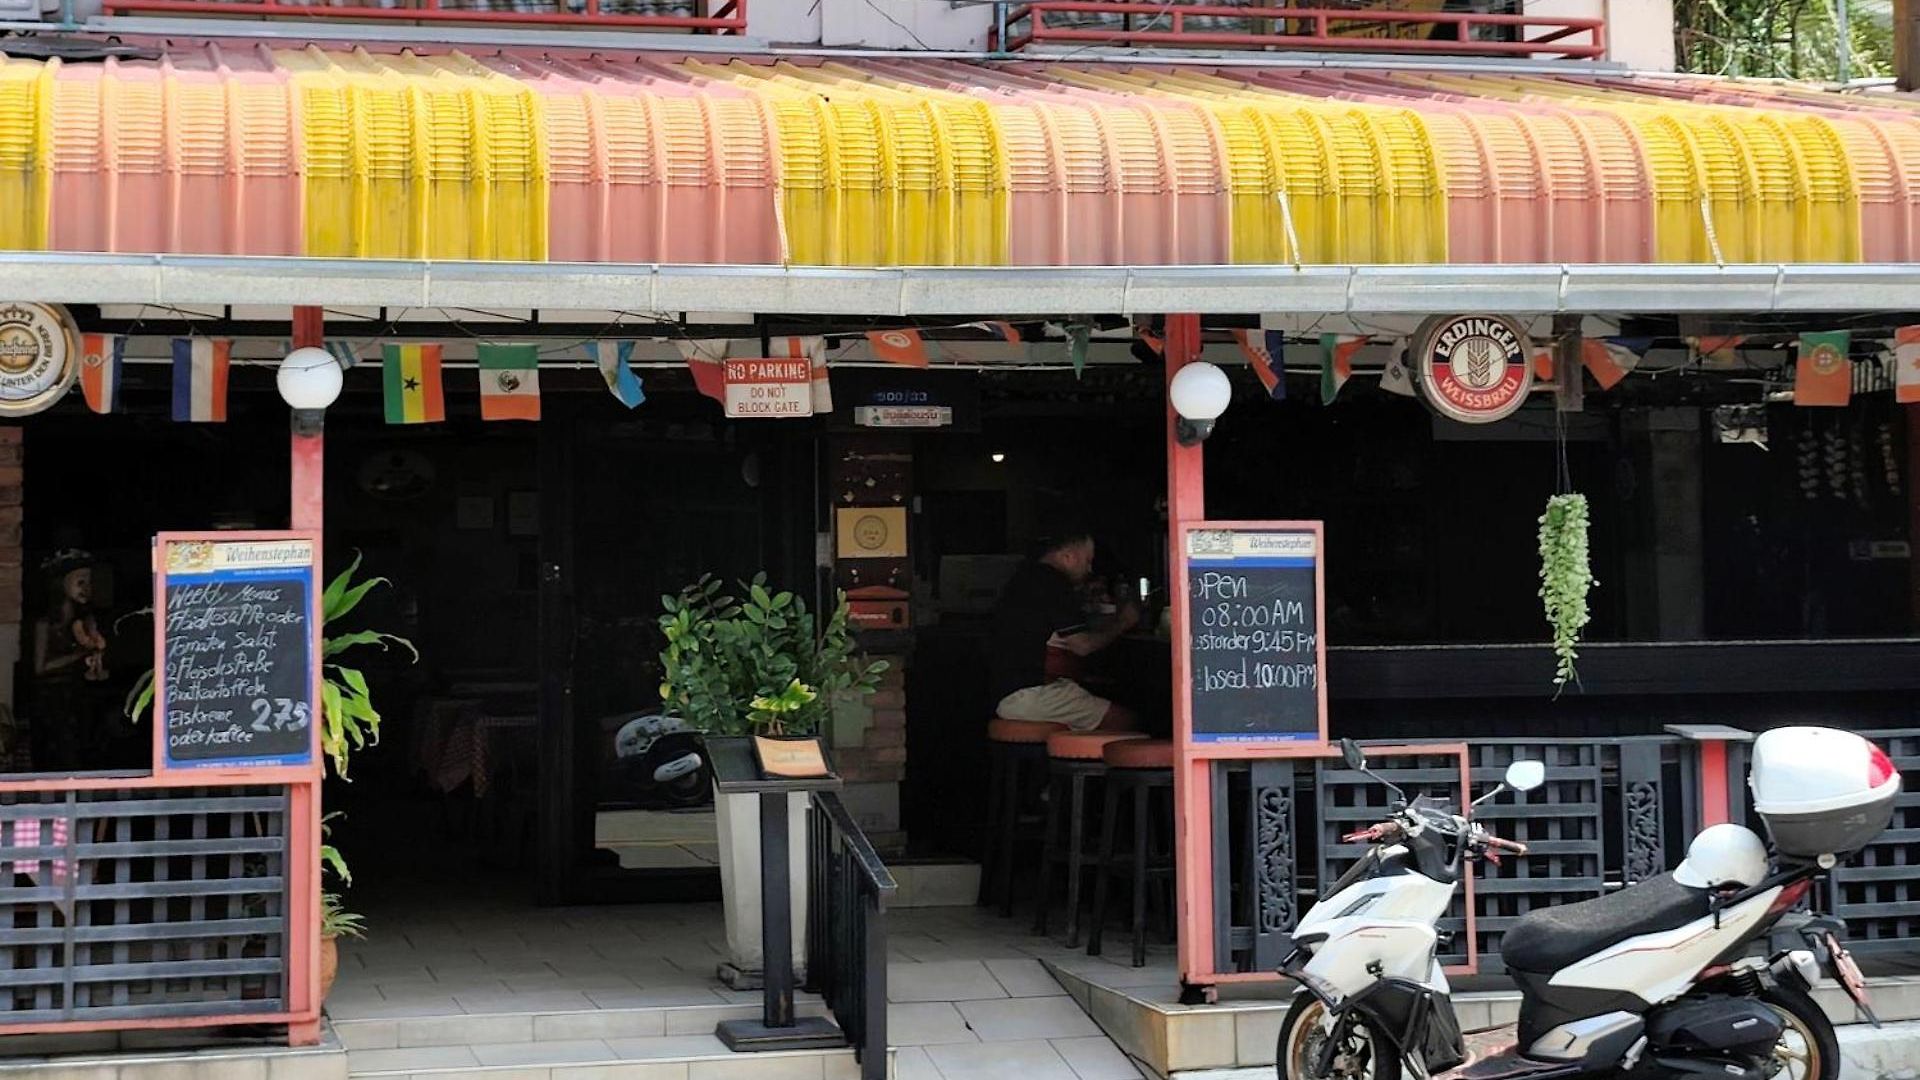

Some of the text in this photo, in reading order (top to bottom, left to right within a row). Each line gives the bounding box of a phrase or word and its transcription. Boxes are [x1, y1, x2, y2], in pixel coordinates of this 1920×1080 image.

[1435, 319, 1520, 358] ERDINGER
[34, 359, 50, 378] DEN
[728, 363, 806, 379] NO PARKING
[750, 387, 786, 398] DO NOT
[738, 401, 800, 412] BLOCK GATE
[225, 545, 310, 563] Weihenstephan
[1202, 599, 1304, 627] 08:00 AM
[1252, 629, 1295, 653] 9:45
[1200, 657, 1249, 692] losed
[251, 698, 309, 732] 275
